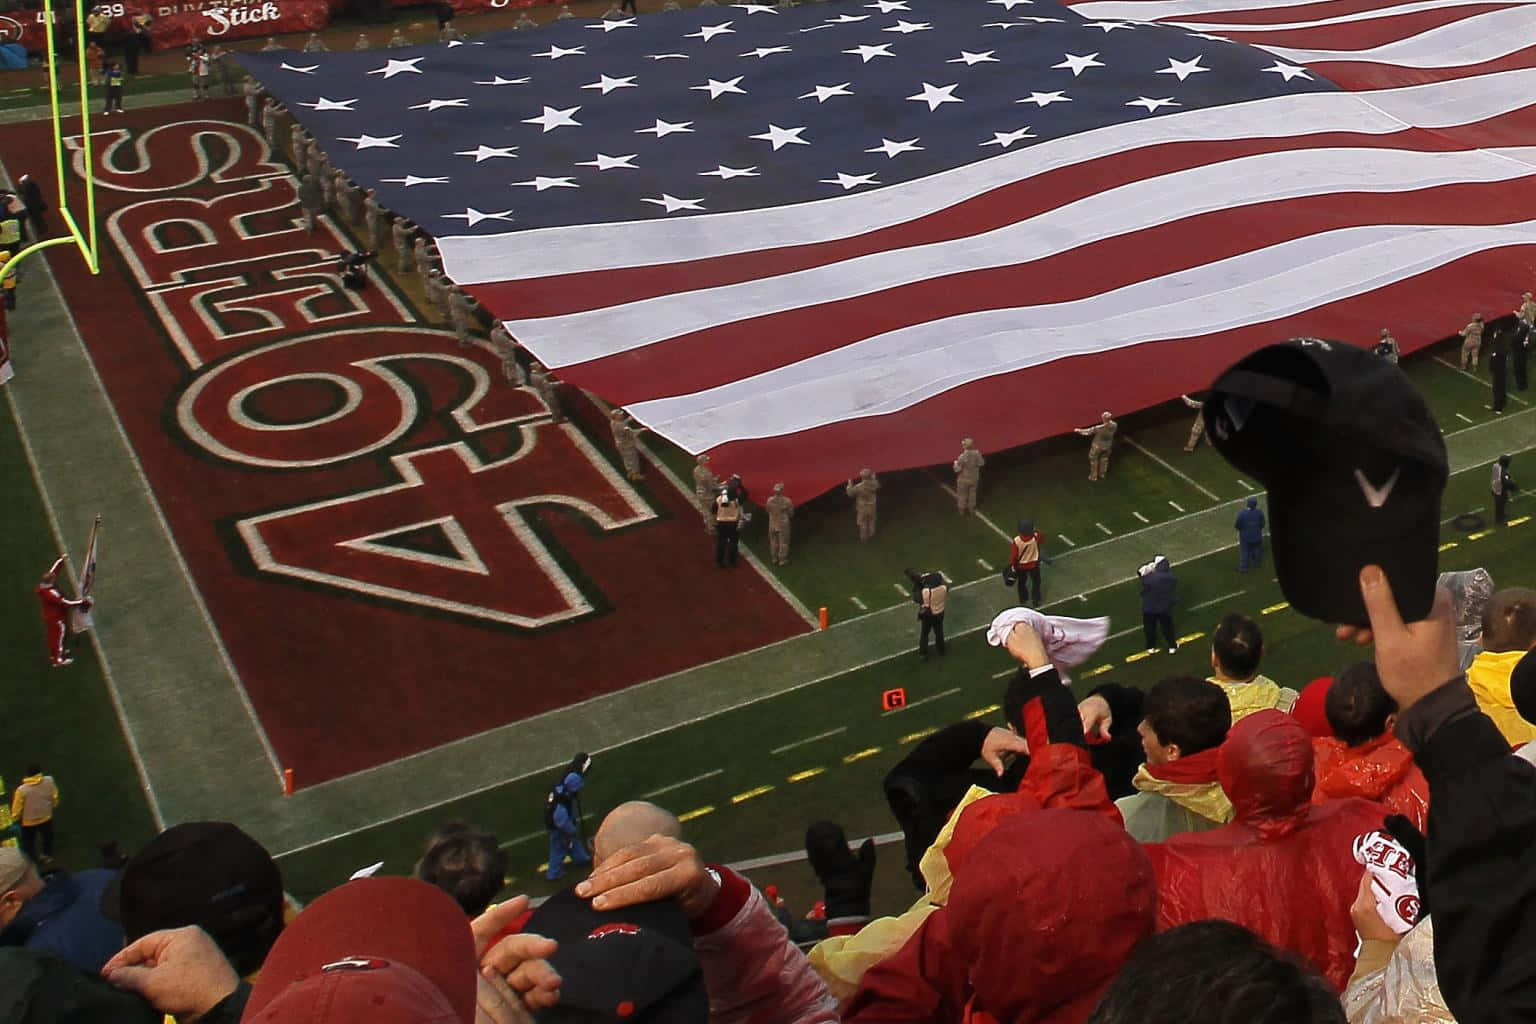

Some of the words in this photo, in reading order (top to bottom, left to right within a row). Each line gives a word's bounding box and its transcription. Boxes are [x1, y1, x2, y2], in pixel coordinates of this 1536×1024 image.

[101, 4, 125, 19] 39
[202, 2, 281, 35] Stick
[62, 120, 657, 628] 49ERS
